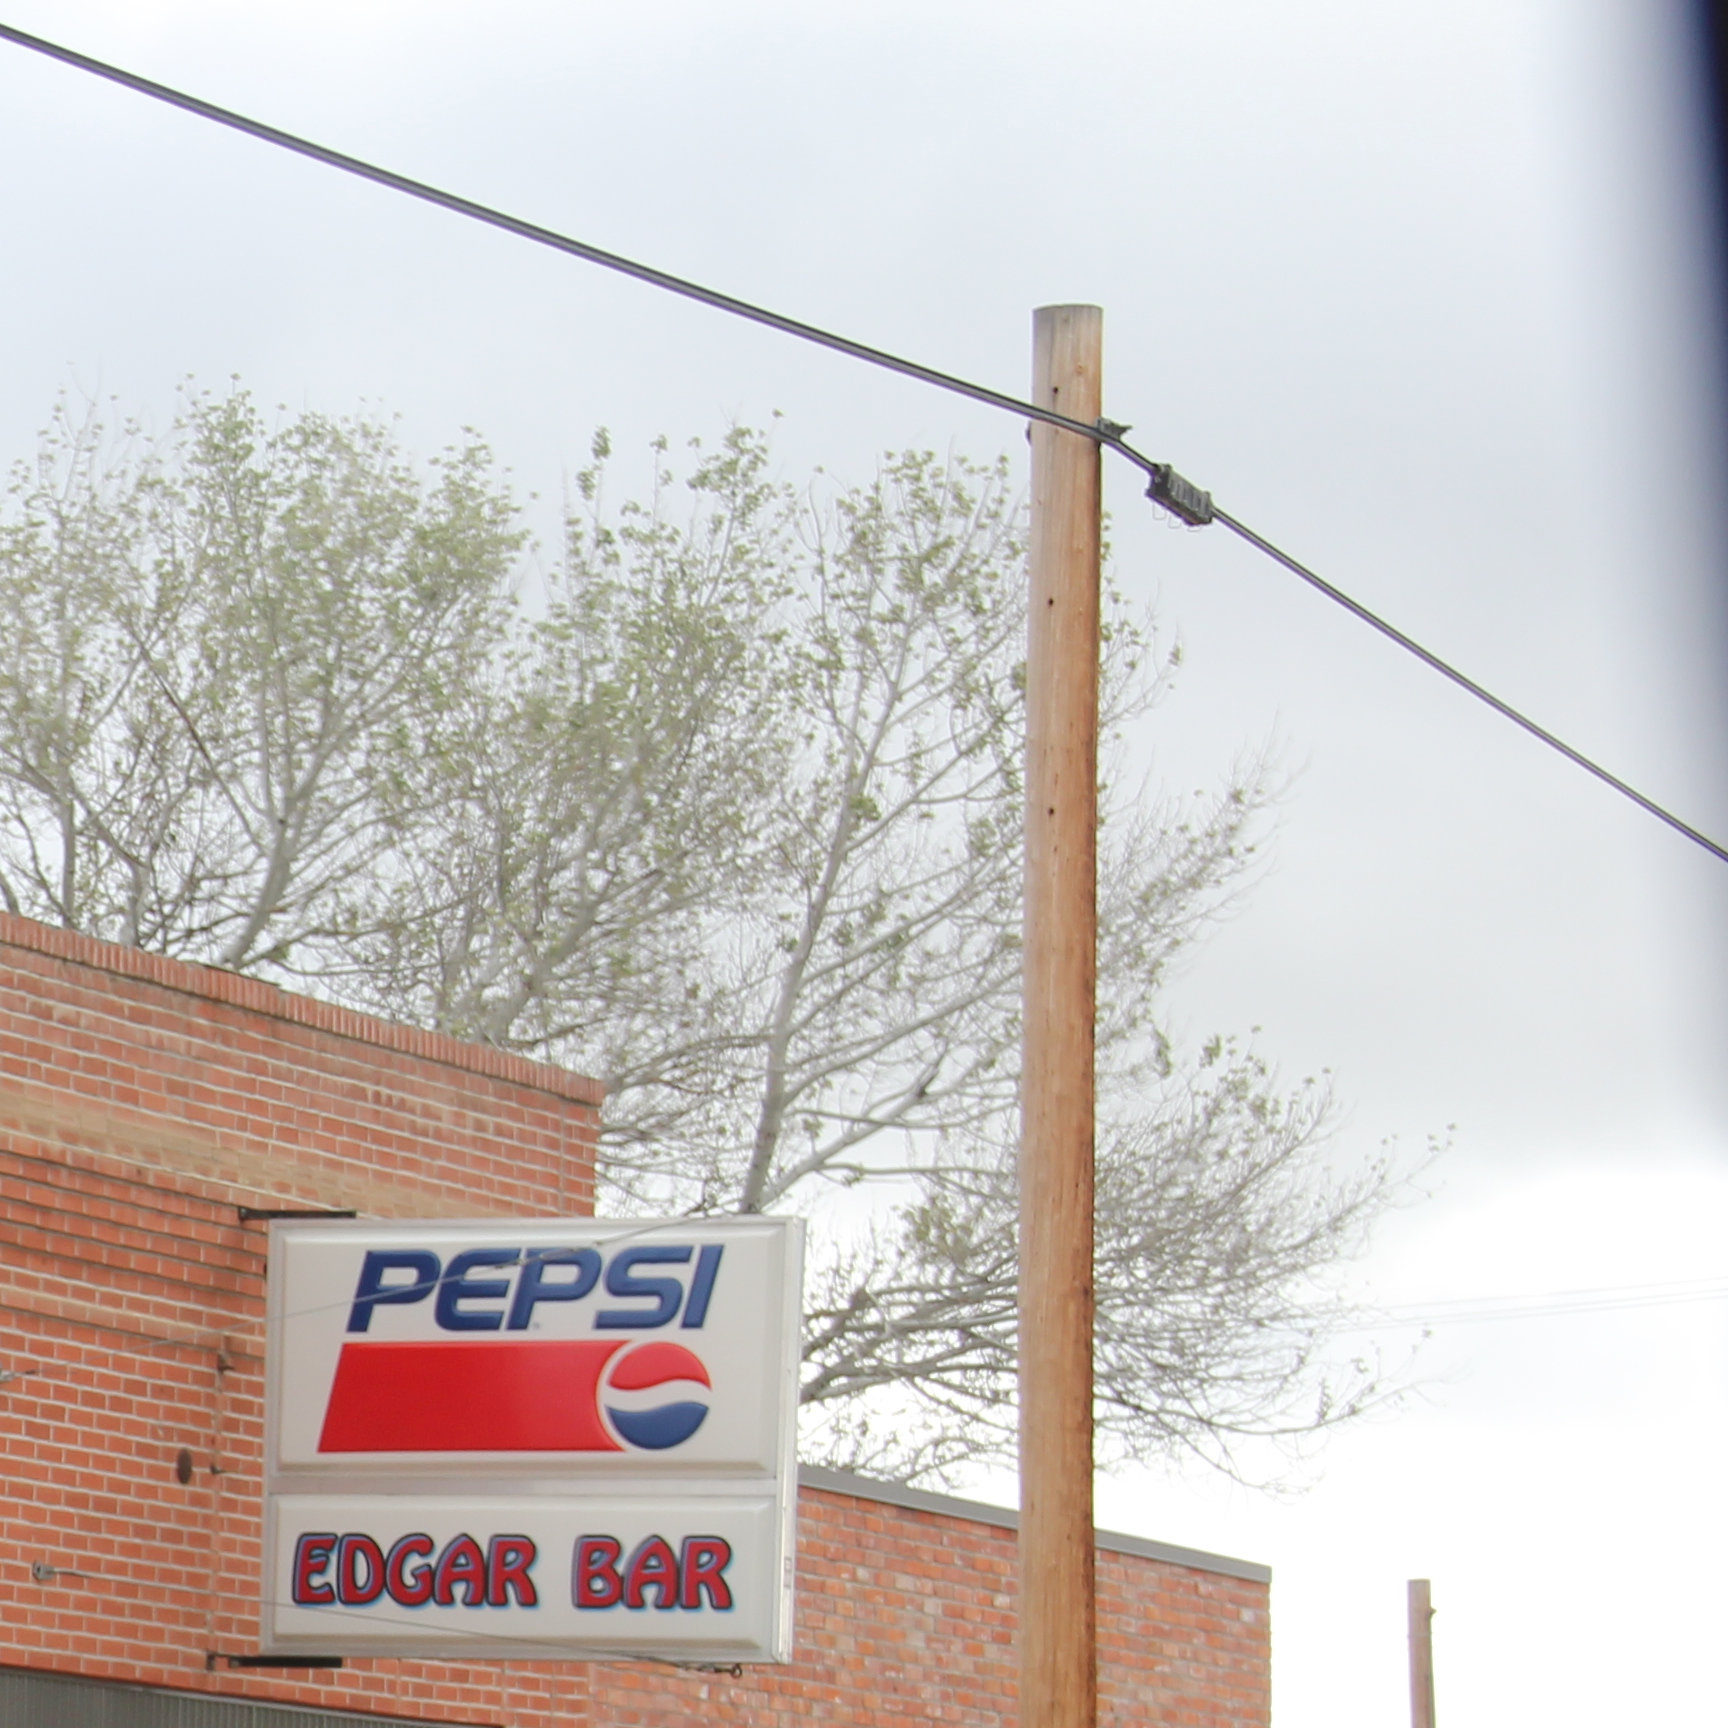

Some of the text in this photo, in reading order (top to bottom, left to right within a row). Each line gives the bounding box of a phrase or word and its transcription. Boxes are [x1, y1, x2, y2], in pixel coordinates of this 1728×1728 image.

[345, 1244, 725, 1333] PEPSI
[291, 1532, 735, 1612] EDGAR BAR
